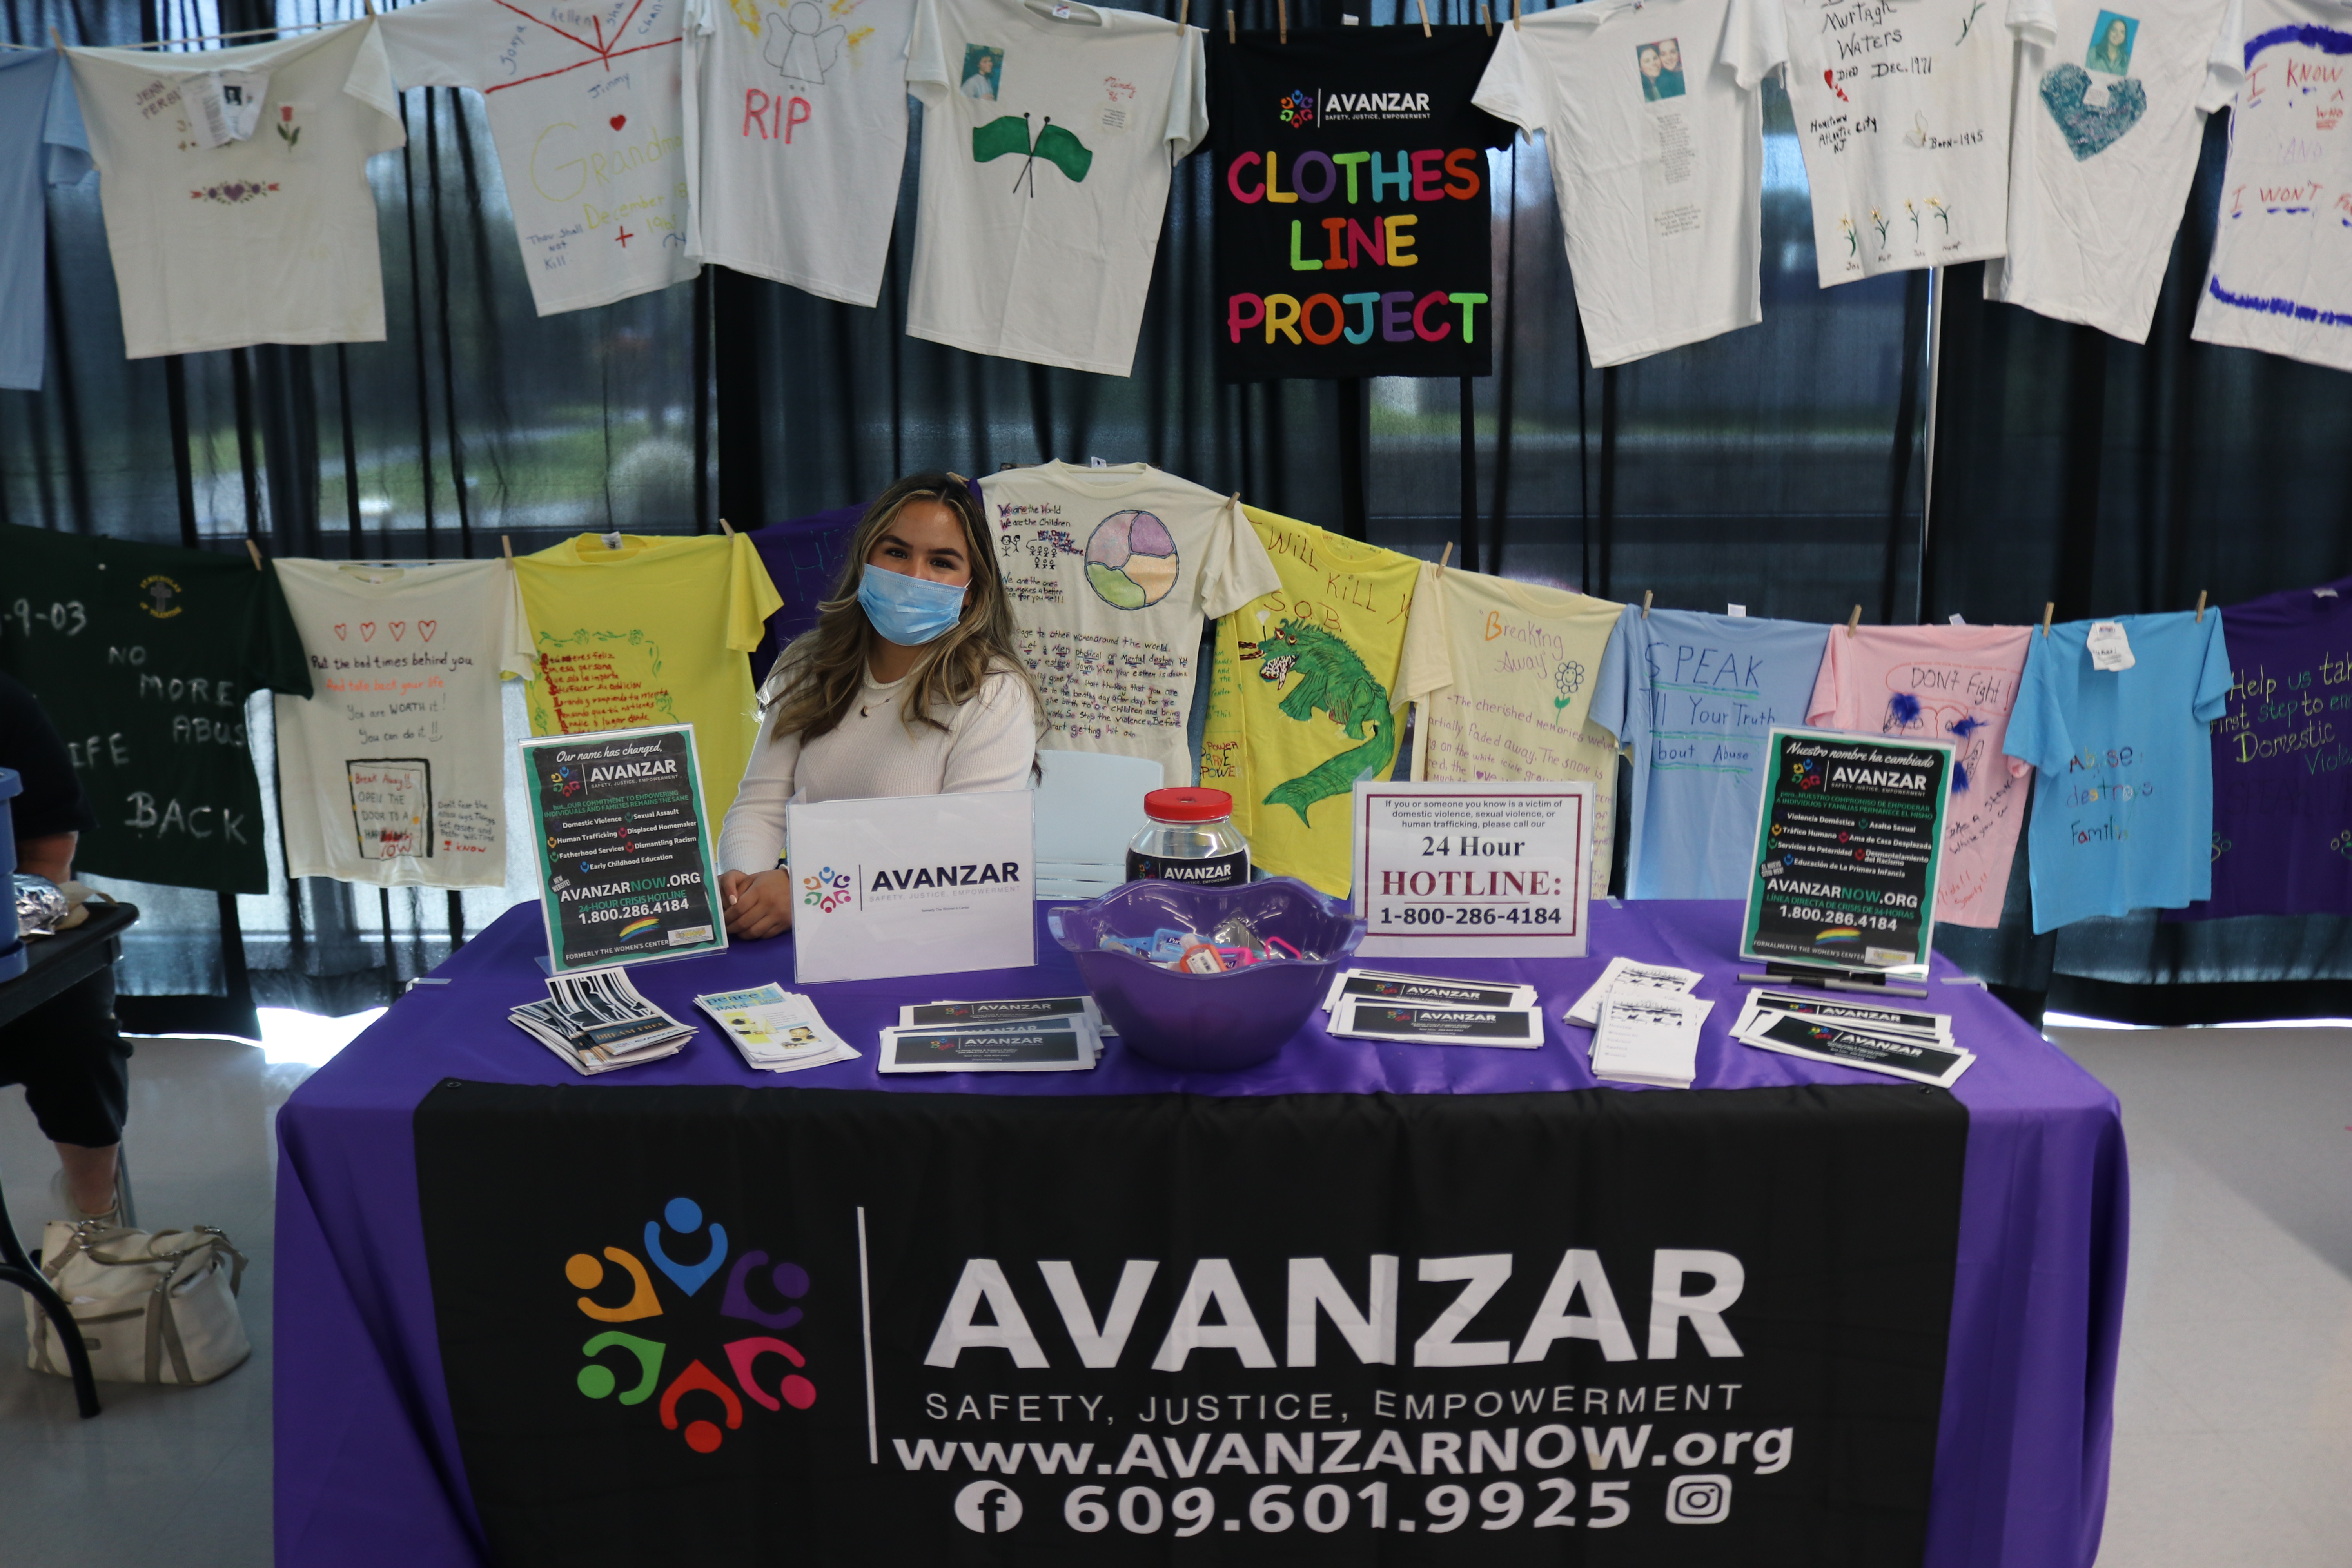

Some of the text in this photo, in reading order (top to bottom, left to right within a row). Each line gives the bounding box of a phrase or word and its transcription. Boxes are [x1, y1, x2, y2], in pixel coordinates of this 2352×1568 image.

[2287, 58, 2342, 88] KNOW
[1325, 93, 1430, 112] AVANZAR
[743, 89, 811, 144] RIP
[1228, 148, 1480, 204] CLOTHES
[2260, 182, 2323, 203] WON'T
[1290, 214, 1418, 271] LINE
[1228, 290, 1488, 345] PROJECT
[1039, 518, 1071, 528] Children
[109, 646, 145, 665] NO
[354, 656, 370, 668] bad
[375, 657, 407, 668] times
[413, 652, 447, 666] behind
[449, 656, 473, 671] you
[1645, 642, 1762, 687] SPEAK
[140, 673, 234, 705] MORE
[2230, 664, 2276, 702] Help
[389, 702, 425, 715] WORTH
[1476, 699, 1532, 723] cherished
[1690, 695, 1775, 726] Your Truth
[2258, 690, 2323, 728] step to
[359, 729, 379, 744] You
[384, 733, 398, 741] can
[403, 729, 414, 739] do
[2232, 720, 2335, 763] Domestic
[557, 740, 662, 763] Our name has changed,
[1713, 745, 1749, 762] Abuse
[1786, 742, 1934, 768] Nuestro nombre ha cambiado
[591, 760, 677, 782] AVANZAR
[639, 775, 678, 783] EMPOWERMENT
[1832, 767, 1927, 790] AVANZAR
[125, 791, 246, 844] BACK
[563, 809, 679, 829] Domestic Violence Sexual Assault
[1434, 820, 1480, 829] trafficking,
[1506, 810, 1544, 818] violence,
[557, 820, 696, 844] Human Trafficking Displaced Homemaker
[1869, 821, 1915, 833] Asalto Sexual
[559, 845, 624, 859] Fatherhood Services
[635, 840, 673, 850] Dismantling
[1421, 836, 1525, 857] 24 Hour
[607, 858, 640, 869] Childhood
[642, 854, 673, 864] Education
[1164, 864, 1231, 879] AVANZAR
[561, 872, 700, 902] AVANZARNOW.ORG
[871, 862, 1020, 892] AVANZAR
[1381, 871, 1561, 896] HOTLINE:
[579, 890, 686, 913] 24-HOUR CRISIS HOTLINE
[953, 886, 1020, 896] EMPOWERMENT
[1767, 878, 1918, 908] AVANZARNOW.ORG
[579, 898, 689, 925] 1.800.286.4184
[1381, 908, 1561, 925] 1-800-286-4184
[1779, 905, 1897, 931] 1.800.286.4184
[566, 949, 599, 960] FORMERLY
[614, 943, 644, 953] WOMEN'S
[645, 940, 669, 948] CENTER
[706, 992, 759, 1005] peace
[1407, 987, 1480, 999] AVANZAR
[1420, 1012, 1496, 1021] AVANZAR
[1823, 1007, 1901, 1022] AVANZAR
[596, 1022, 666, 1040] DREAM FREE
[1841, 1034, 1922, 1057] AVANZAR
[924, 1249, 1744, 1372] AVANZAR
[926, 1384, 1742, 1425] SAFETY, JUSTICE, EMPOWERMENT
[893, 1424, 1793, 1480] www.AVANZARNOW.org
[1064, 1478, 1630, 1537] 609.601.9925
